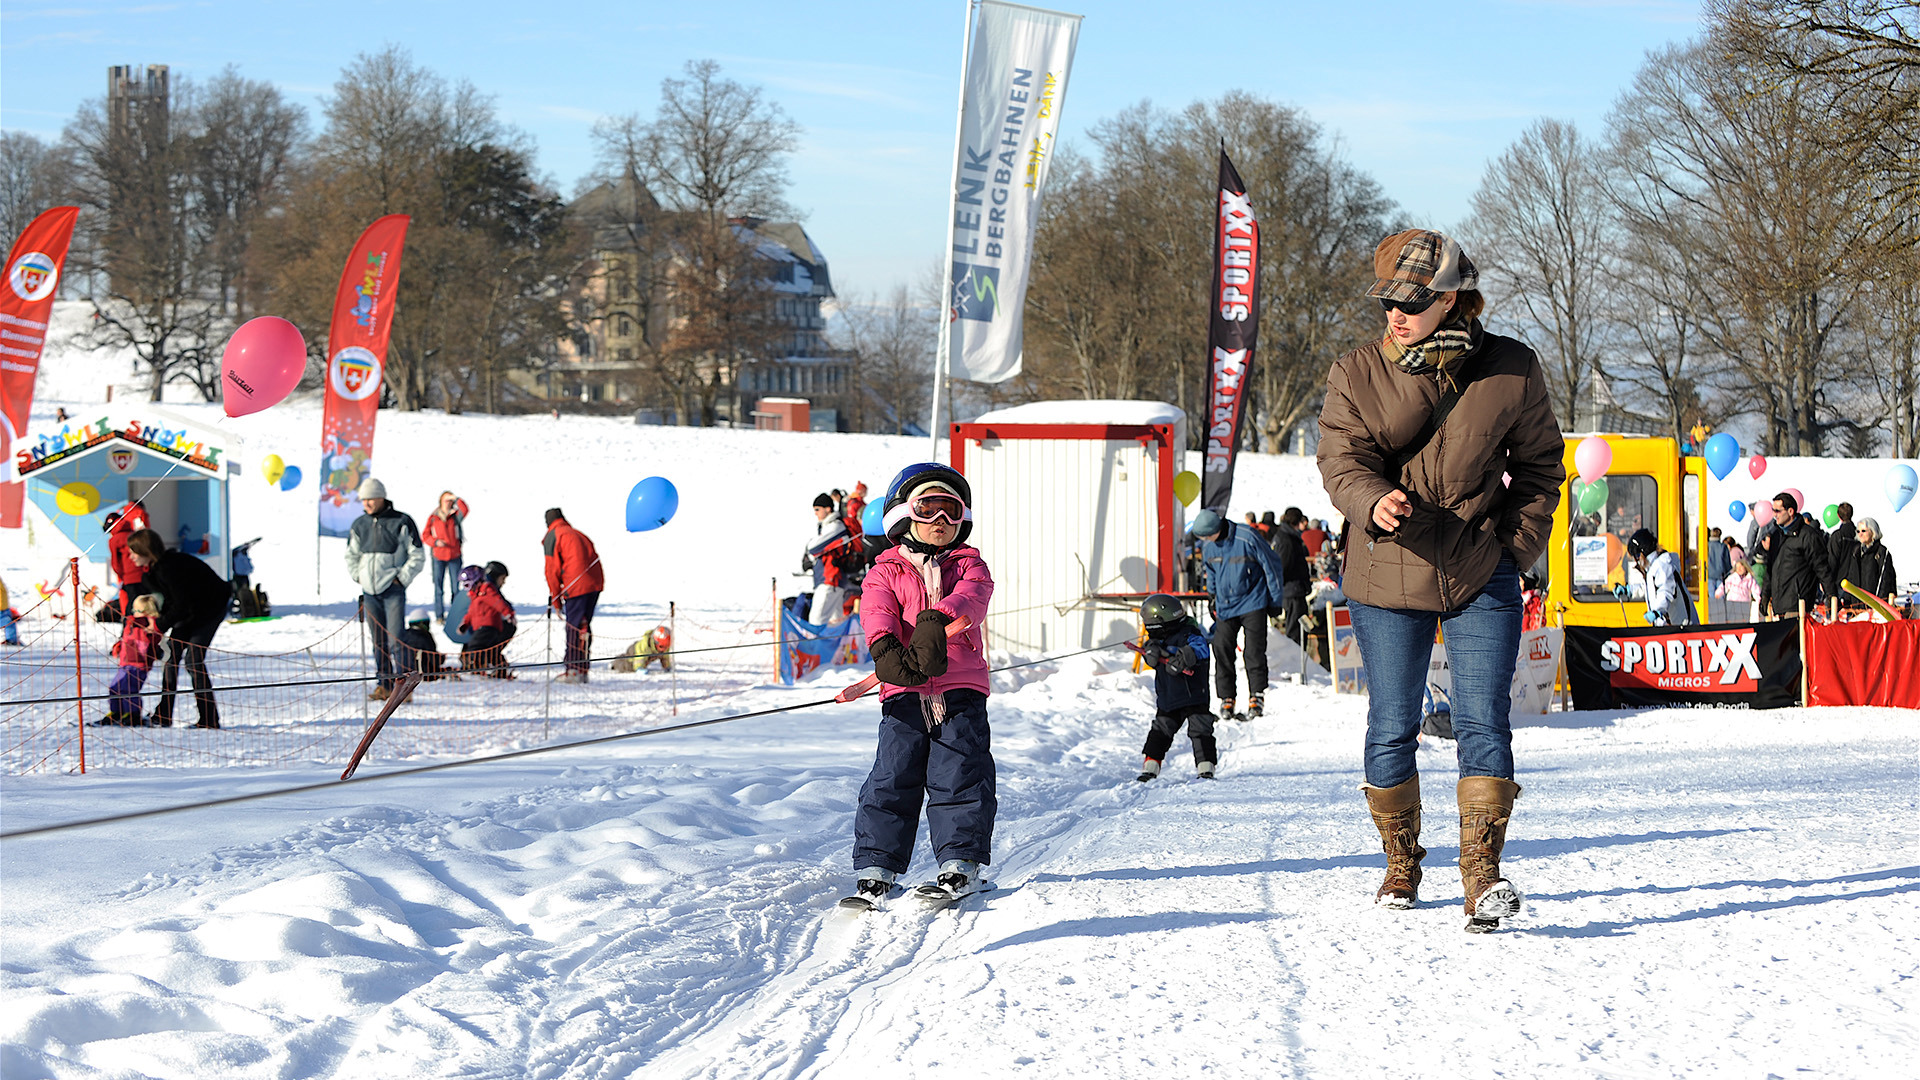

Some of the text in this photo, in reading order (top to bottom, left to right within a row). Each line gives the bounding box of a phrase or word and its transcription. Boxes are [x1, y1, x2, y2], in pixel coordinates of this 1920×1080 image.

[952, 145, 992, 255] LENK
[985, 68, 1033, 259] BERGBAHNEN
[1221, 187, 1256, 322] SPORTXX
[1600, 632, 1763, 685] SPORTXX
[1658, 676, 1711, 688] MIGROS
